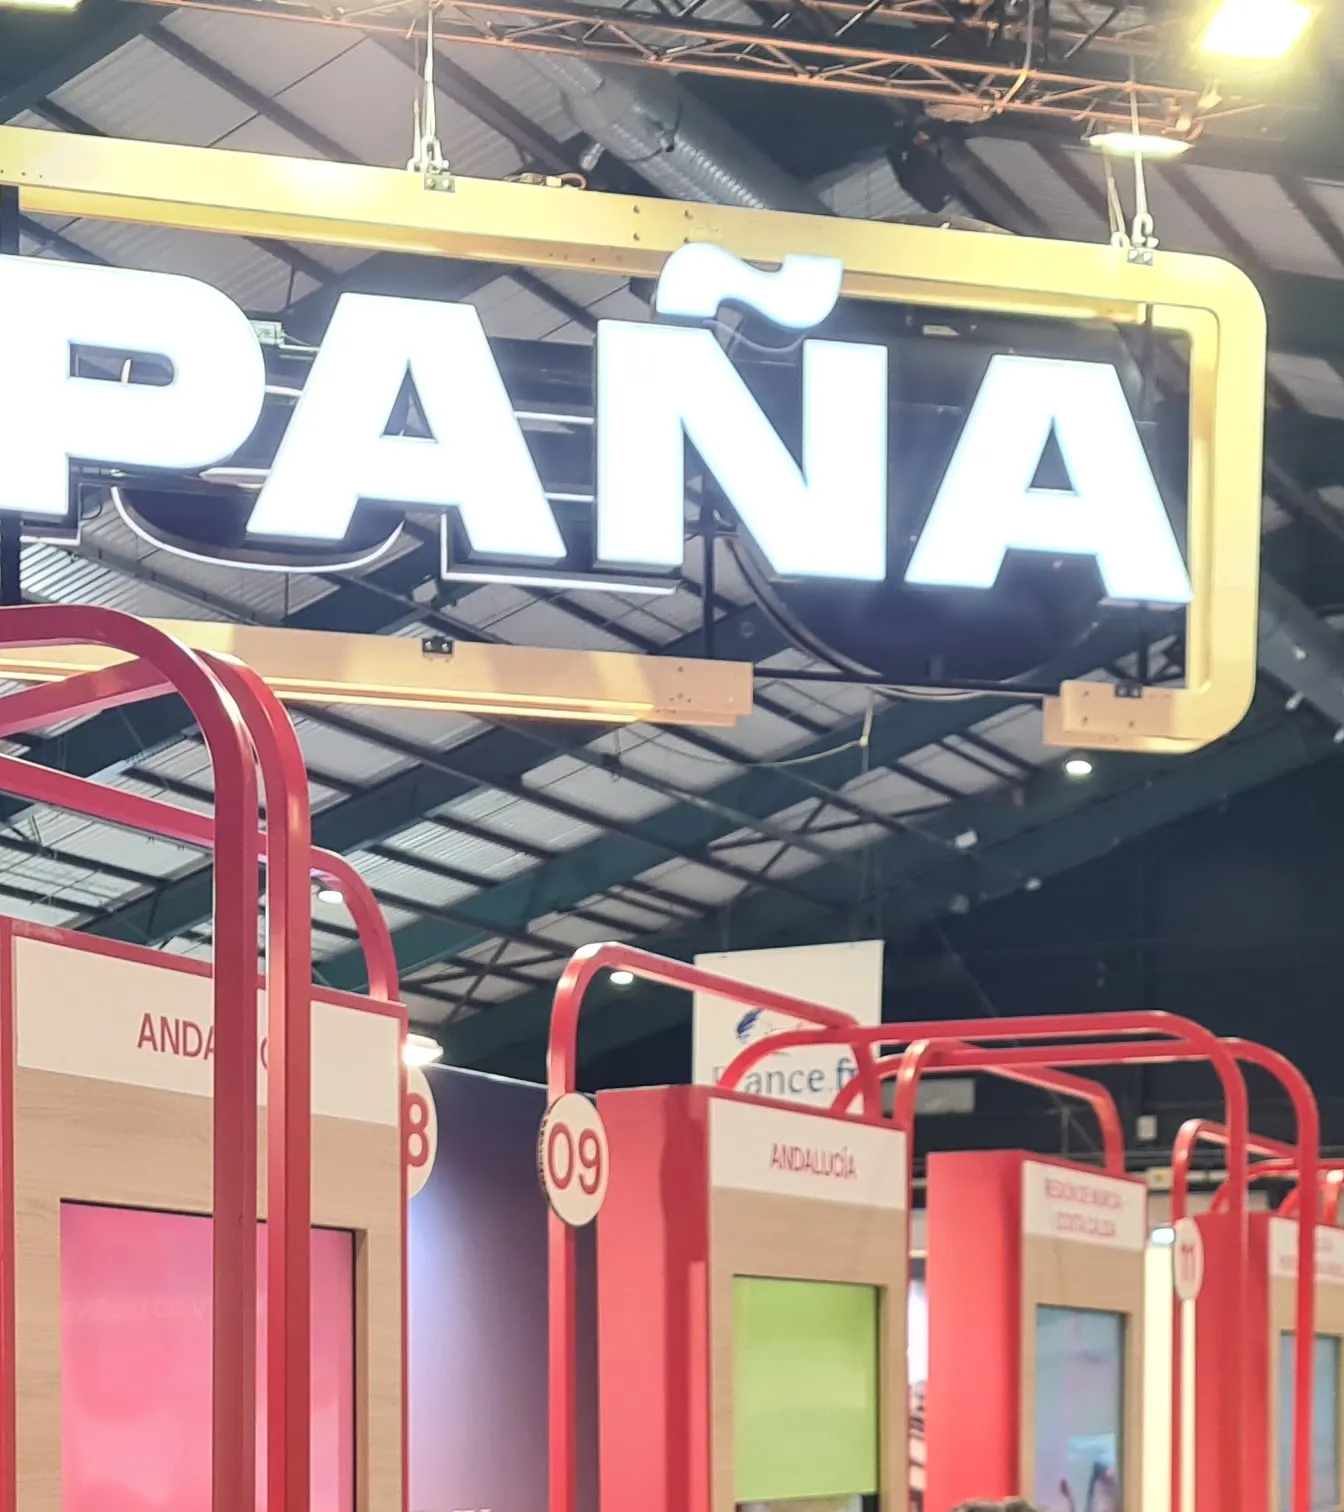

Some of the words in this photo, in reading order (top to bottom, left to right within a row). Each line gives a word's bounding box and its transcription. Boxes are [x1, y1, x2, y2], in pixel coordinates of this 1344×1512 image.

[407, 1093, 430, 1167] 8
[548, 1122, 600, 1195] 09
[770, 1143, 857, 1180] ANDALUCÍA
